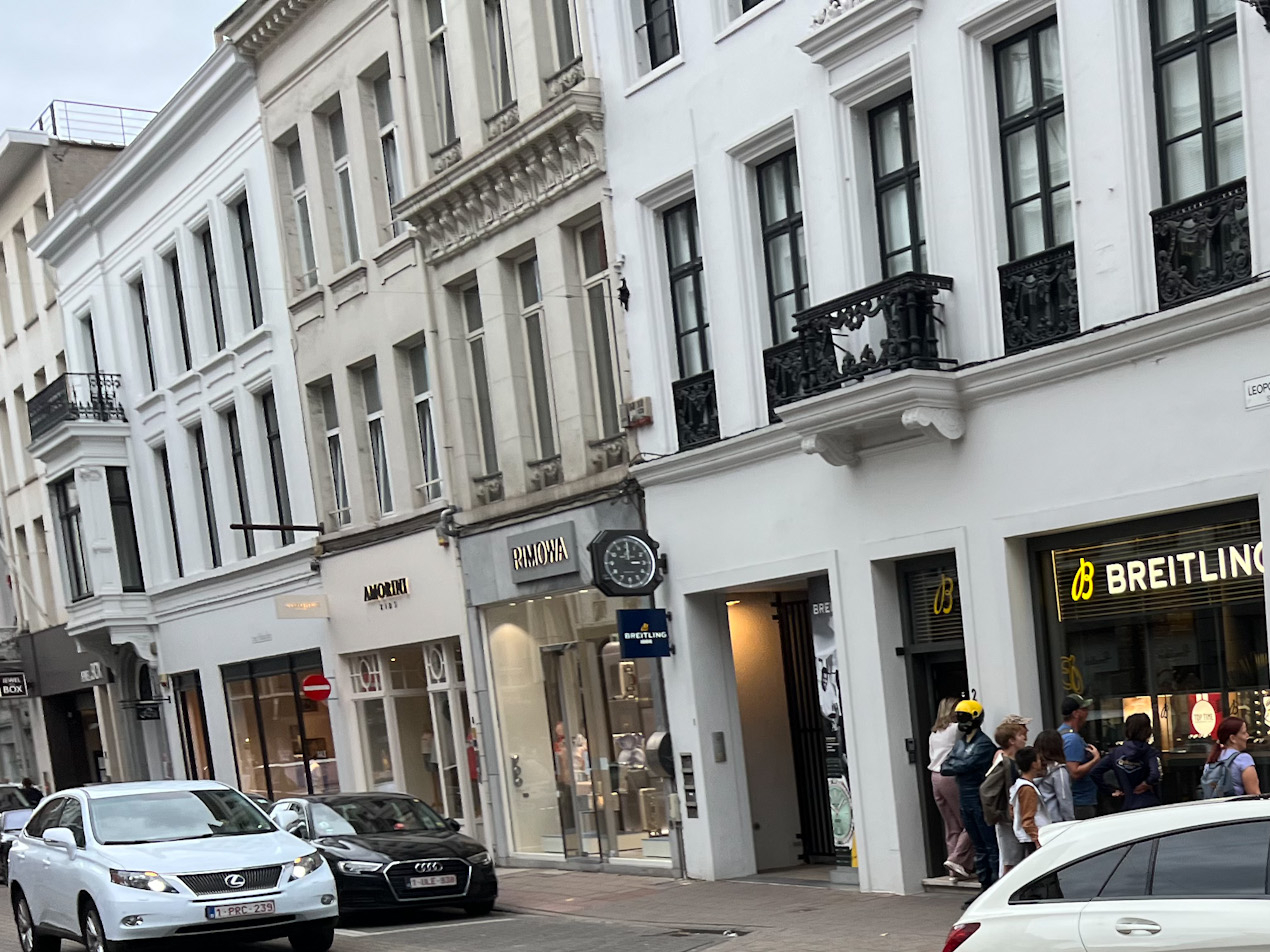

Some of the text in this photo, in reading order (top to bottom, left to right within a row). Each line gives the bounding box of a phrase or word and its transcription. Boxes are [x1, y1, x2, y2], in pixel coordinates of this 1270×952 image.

[513, 536, 569, 571] RIMOWA
[364, 577, 409, 602] AMORINI
[624, 631, 668, 640] BREITLING
[3, 684, 23, 694] BOX
[216, 902, 273, 918] 1-PRC-239
